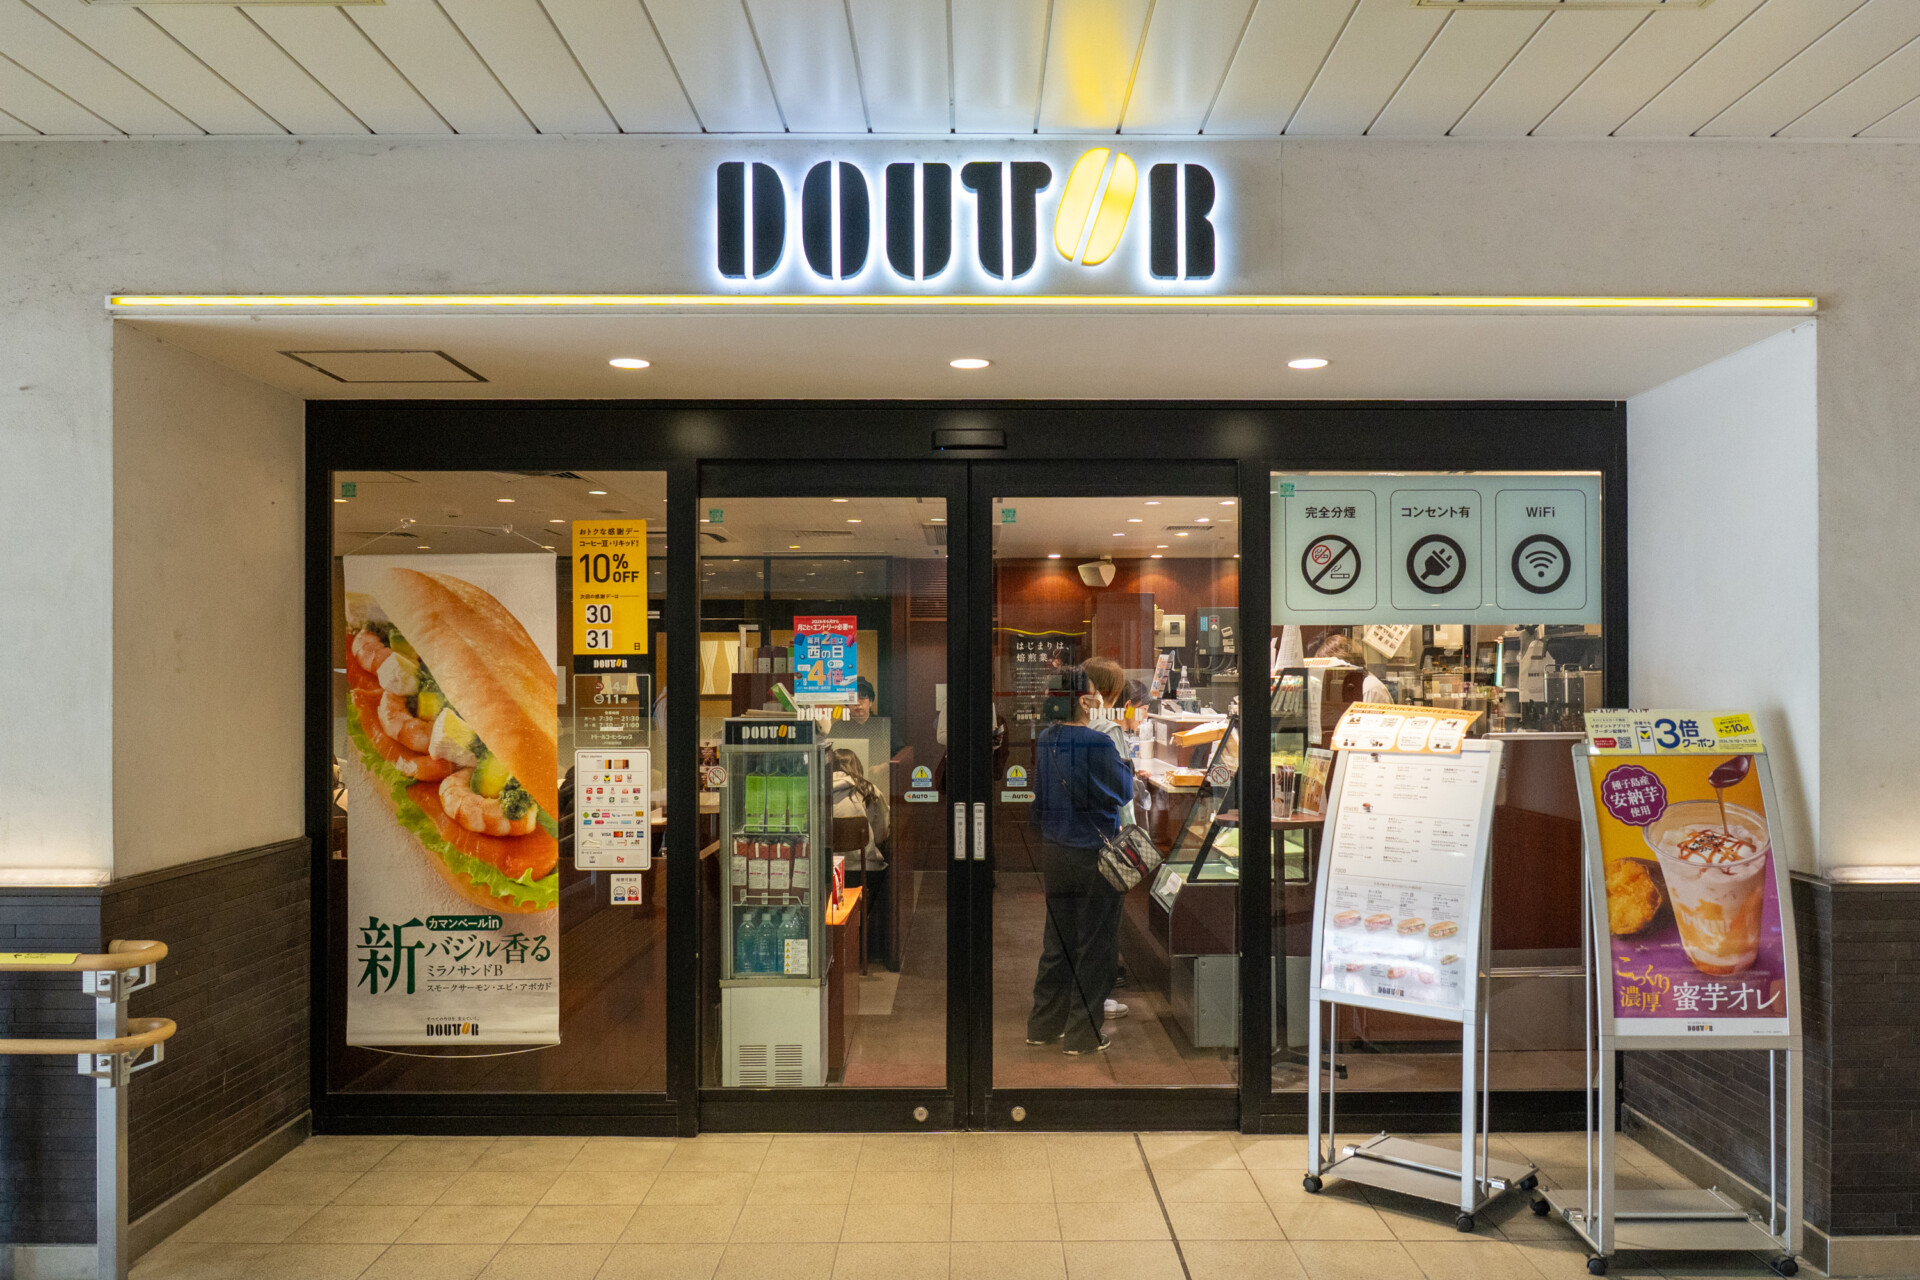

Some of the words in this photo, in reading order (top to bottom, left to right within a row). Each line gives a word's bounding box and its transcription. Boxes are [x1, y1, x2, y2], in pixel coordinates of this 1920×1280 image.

[717, 147, 1216, 281] DOUTOR
[1305, 506, 1356, 519] 完全分煙
[1401, 506, 1471, 518] コンセント有
[1526, 507, 1555, 518] WiFi
[612, 571, 640, 583] OFF
[586, 605, 611, 624] 30
[587, 629, 609, 649] 31
[633, 642, 641, 651] 日
[593, 658, 628, 669] DOUTOR
[796, 705, 850, 721] DOUTOR
[741, 724, 797, 739] DOUTOR
[1682, 738, 1715, 748] クーポン
[1610, 786, 1660, 809] 安納芋
[1630, 805, 1651, 818] 使用
[428, 916, 500, 929] カマンベールin
[424, 932, 551, 964] バジル香る
[356, 916, 426, 995] 新
[427, 964, 503, 977] ミラノサンドB
[1620, 986, 1662, 1012] 濃厚
[1673, 982, 1781, 1011] 蜜芋オレ
[426, 1022, 479, 1036] DOUTOR
